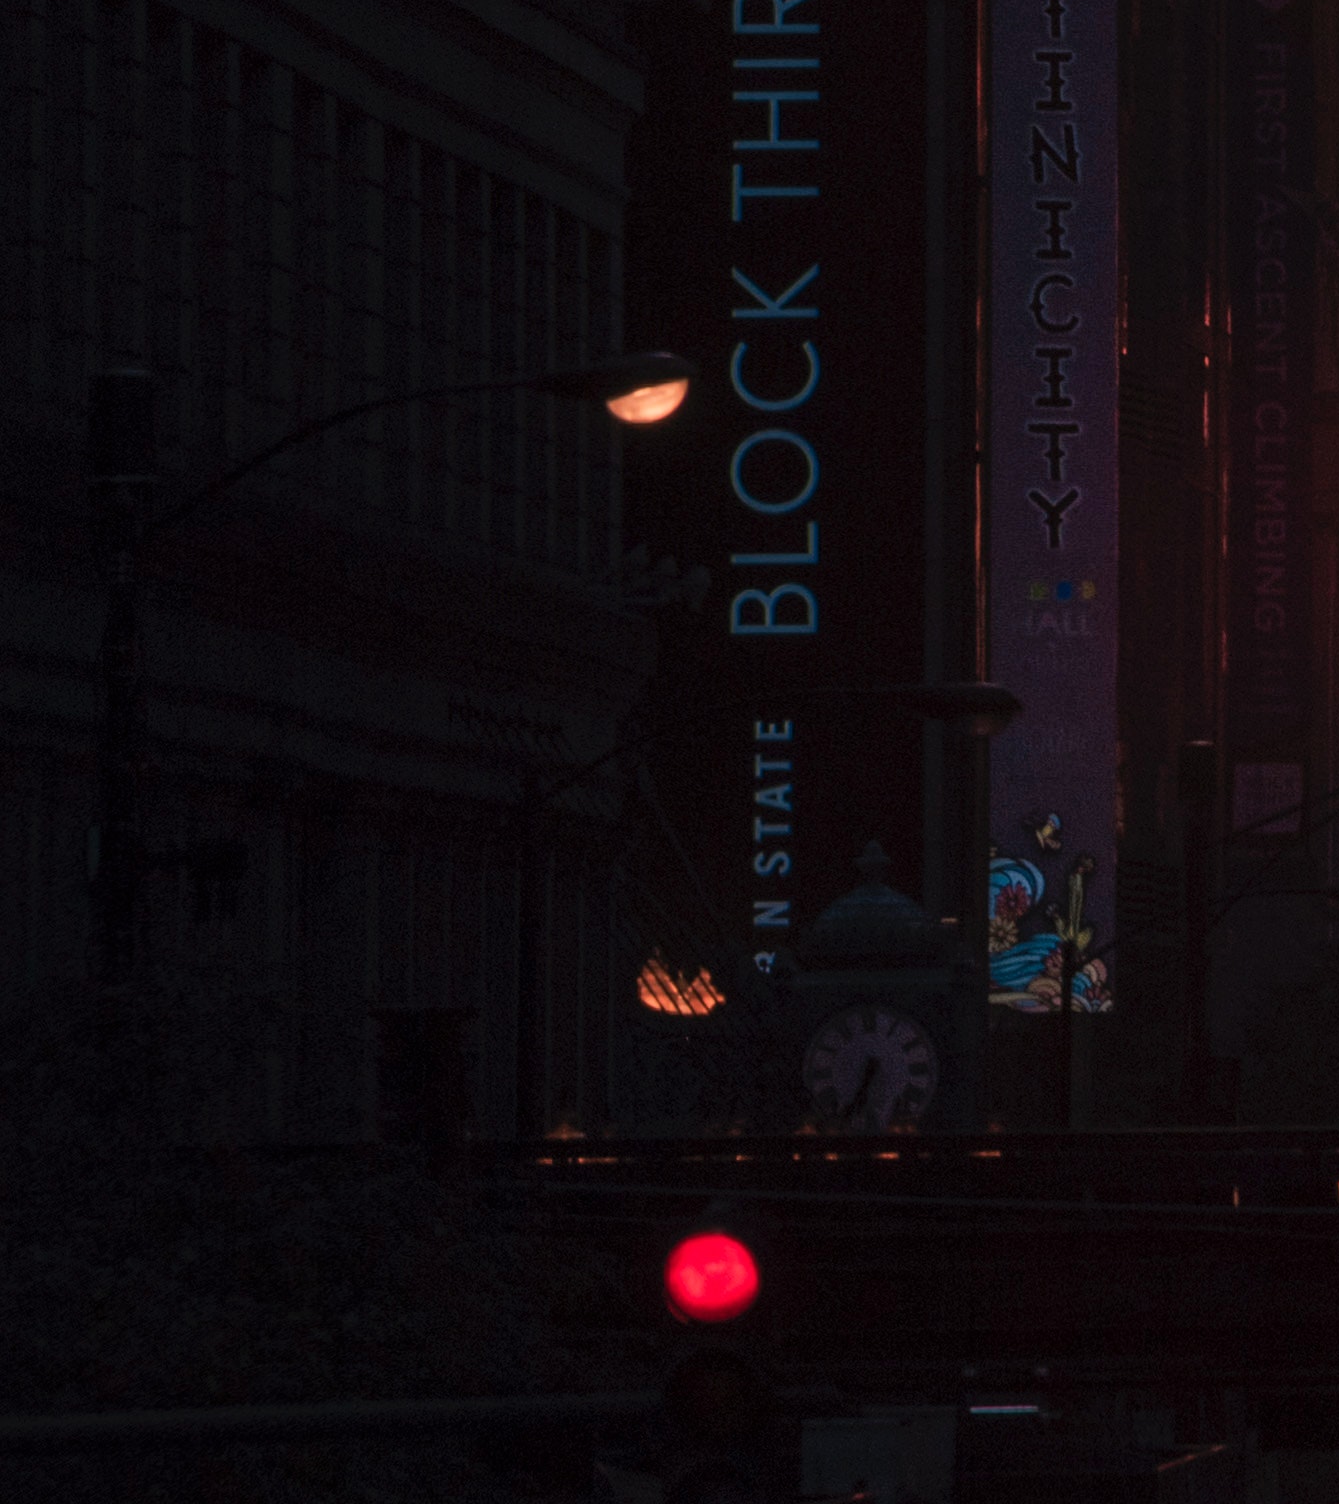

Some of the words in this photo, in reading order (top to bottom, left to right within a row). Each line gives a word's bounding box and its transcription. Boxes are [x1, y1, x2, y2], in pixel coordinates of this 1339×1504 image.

[1253, 42, 1287, 172] FIRST
[1253, 193, 1287, 381] ASCENT
[730, 263, 821, 636] BLOCK
[1253, 401, 1287, 633] CLIMBING
[753, 718, 793, 876] STATE
